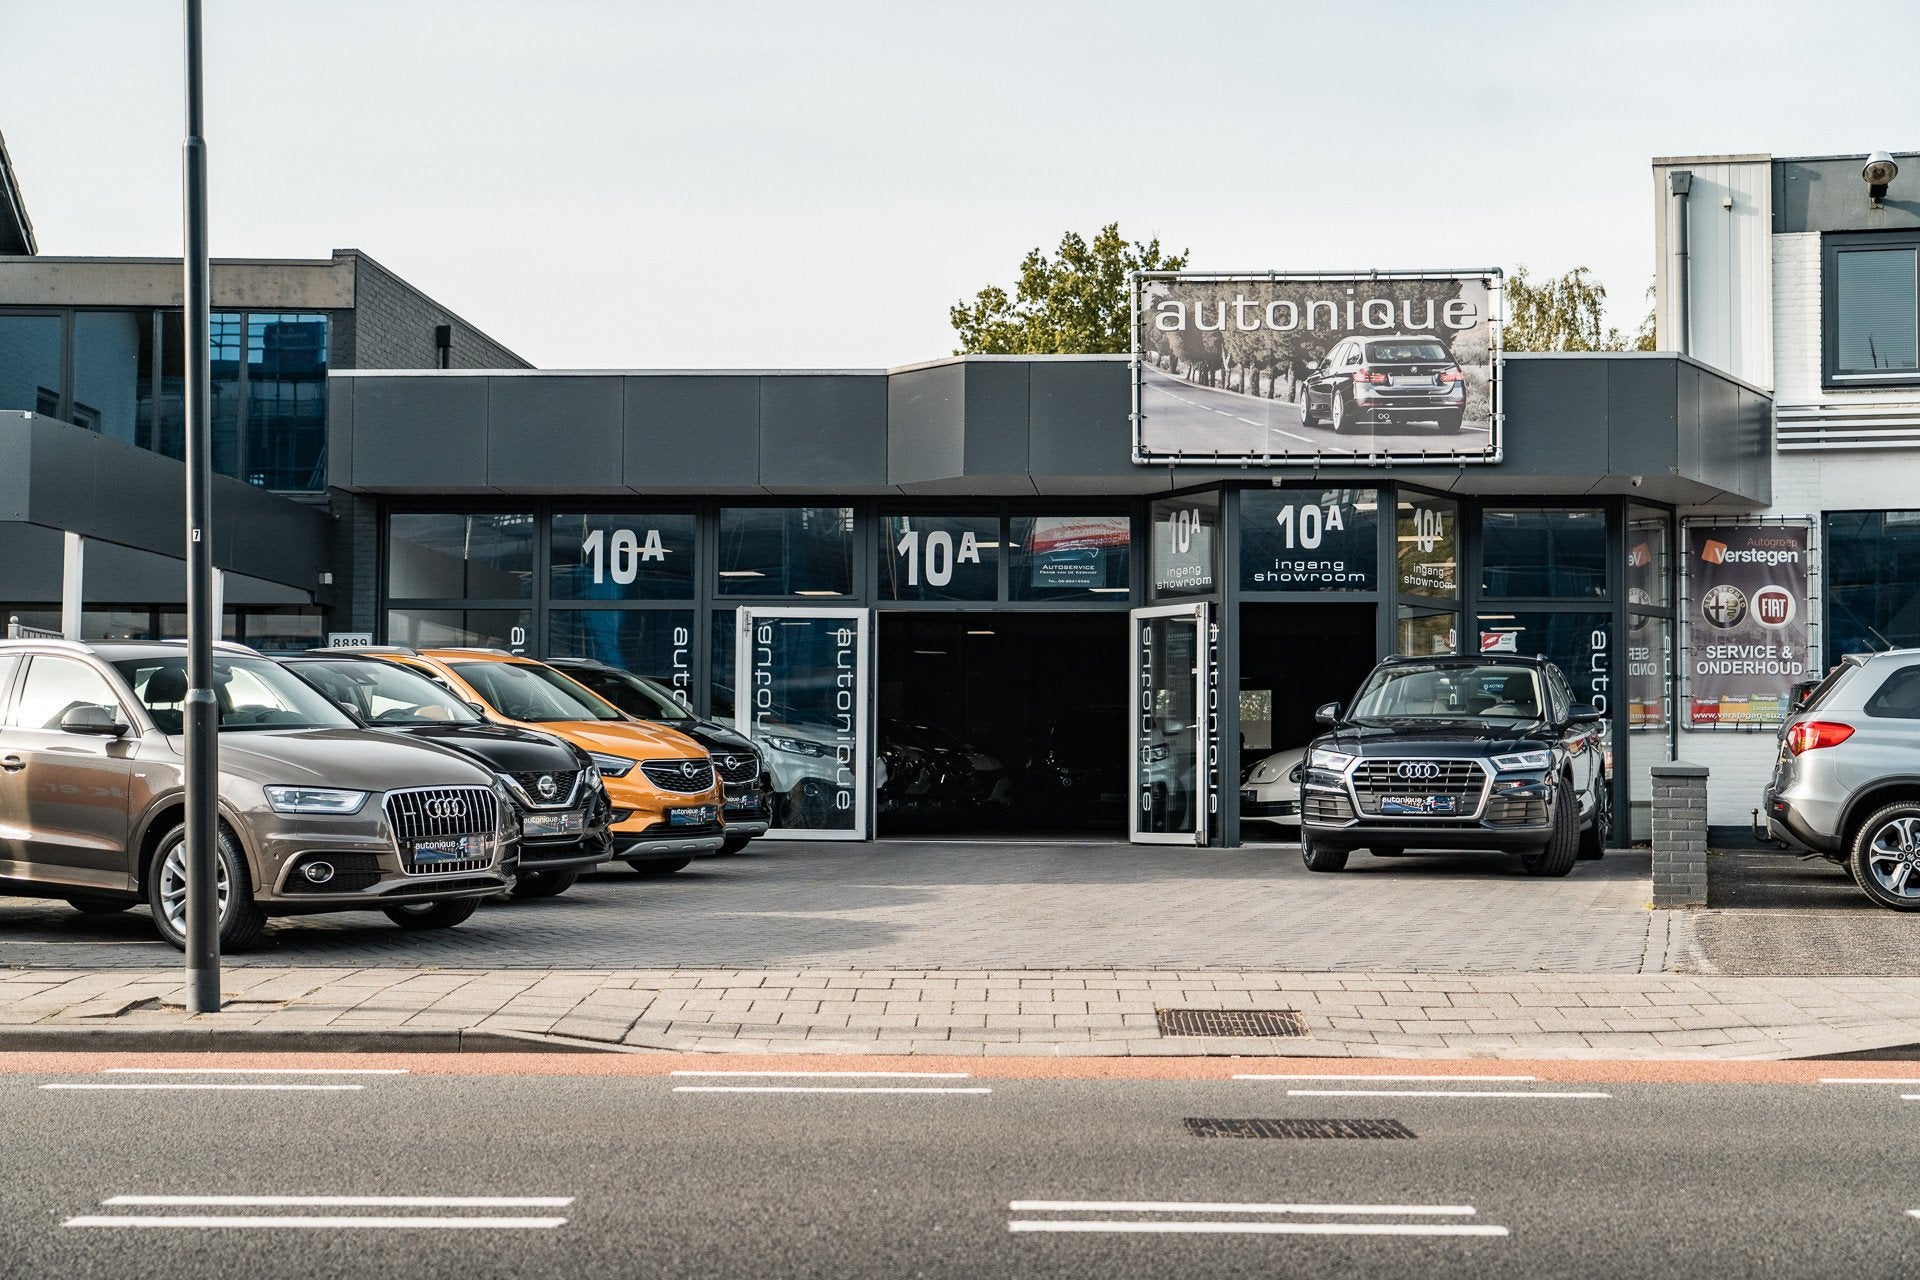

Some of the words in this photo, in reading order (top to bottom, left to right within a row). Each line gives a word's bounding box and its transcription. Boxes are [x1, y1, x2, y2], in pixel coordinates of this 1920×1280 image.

[1155, 288, 1478, 332] autonique
[194, 530, 200, 540] 7
[1168, 509, 1201, 554] 10A
[1276, 504, 1344, 549] 10A
[1413, 508, 1444, 553] 10A
[1747, 537, 1798, 548] Autogroep
[582, 529, 665, 584] 10A
[897, 530, 980, 587] 10A
[1275, 559, 1344, 571] ingang
[1714, 547, 1798, 566] Verstegen
[1167, 565, 1202, 578] ingang
[1254, 570, 1365, 582] showroom
[1413, 562, 1444, 579] ingang
[1157, 576, 1212, 590] showroom
[1403, 574, 1453, 590] showroom
[1761, 598, 1787, 618] FIAT
[1706, 645, 1777, 659] SERVICE
[1781, 645, 1793, 659] &
[1696, 661, 1803, 675] ONDERHOUD
[836, 628, 857, 810] autonique
[1209, 622, 1220, 814] autonique
[415, 840, 456, 850] autonique
